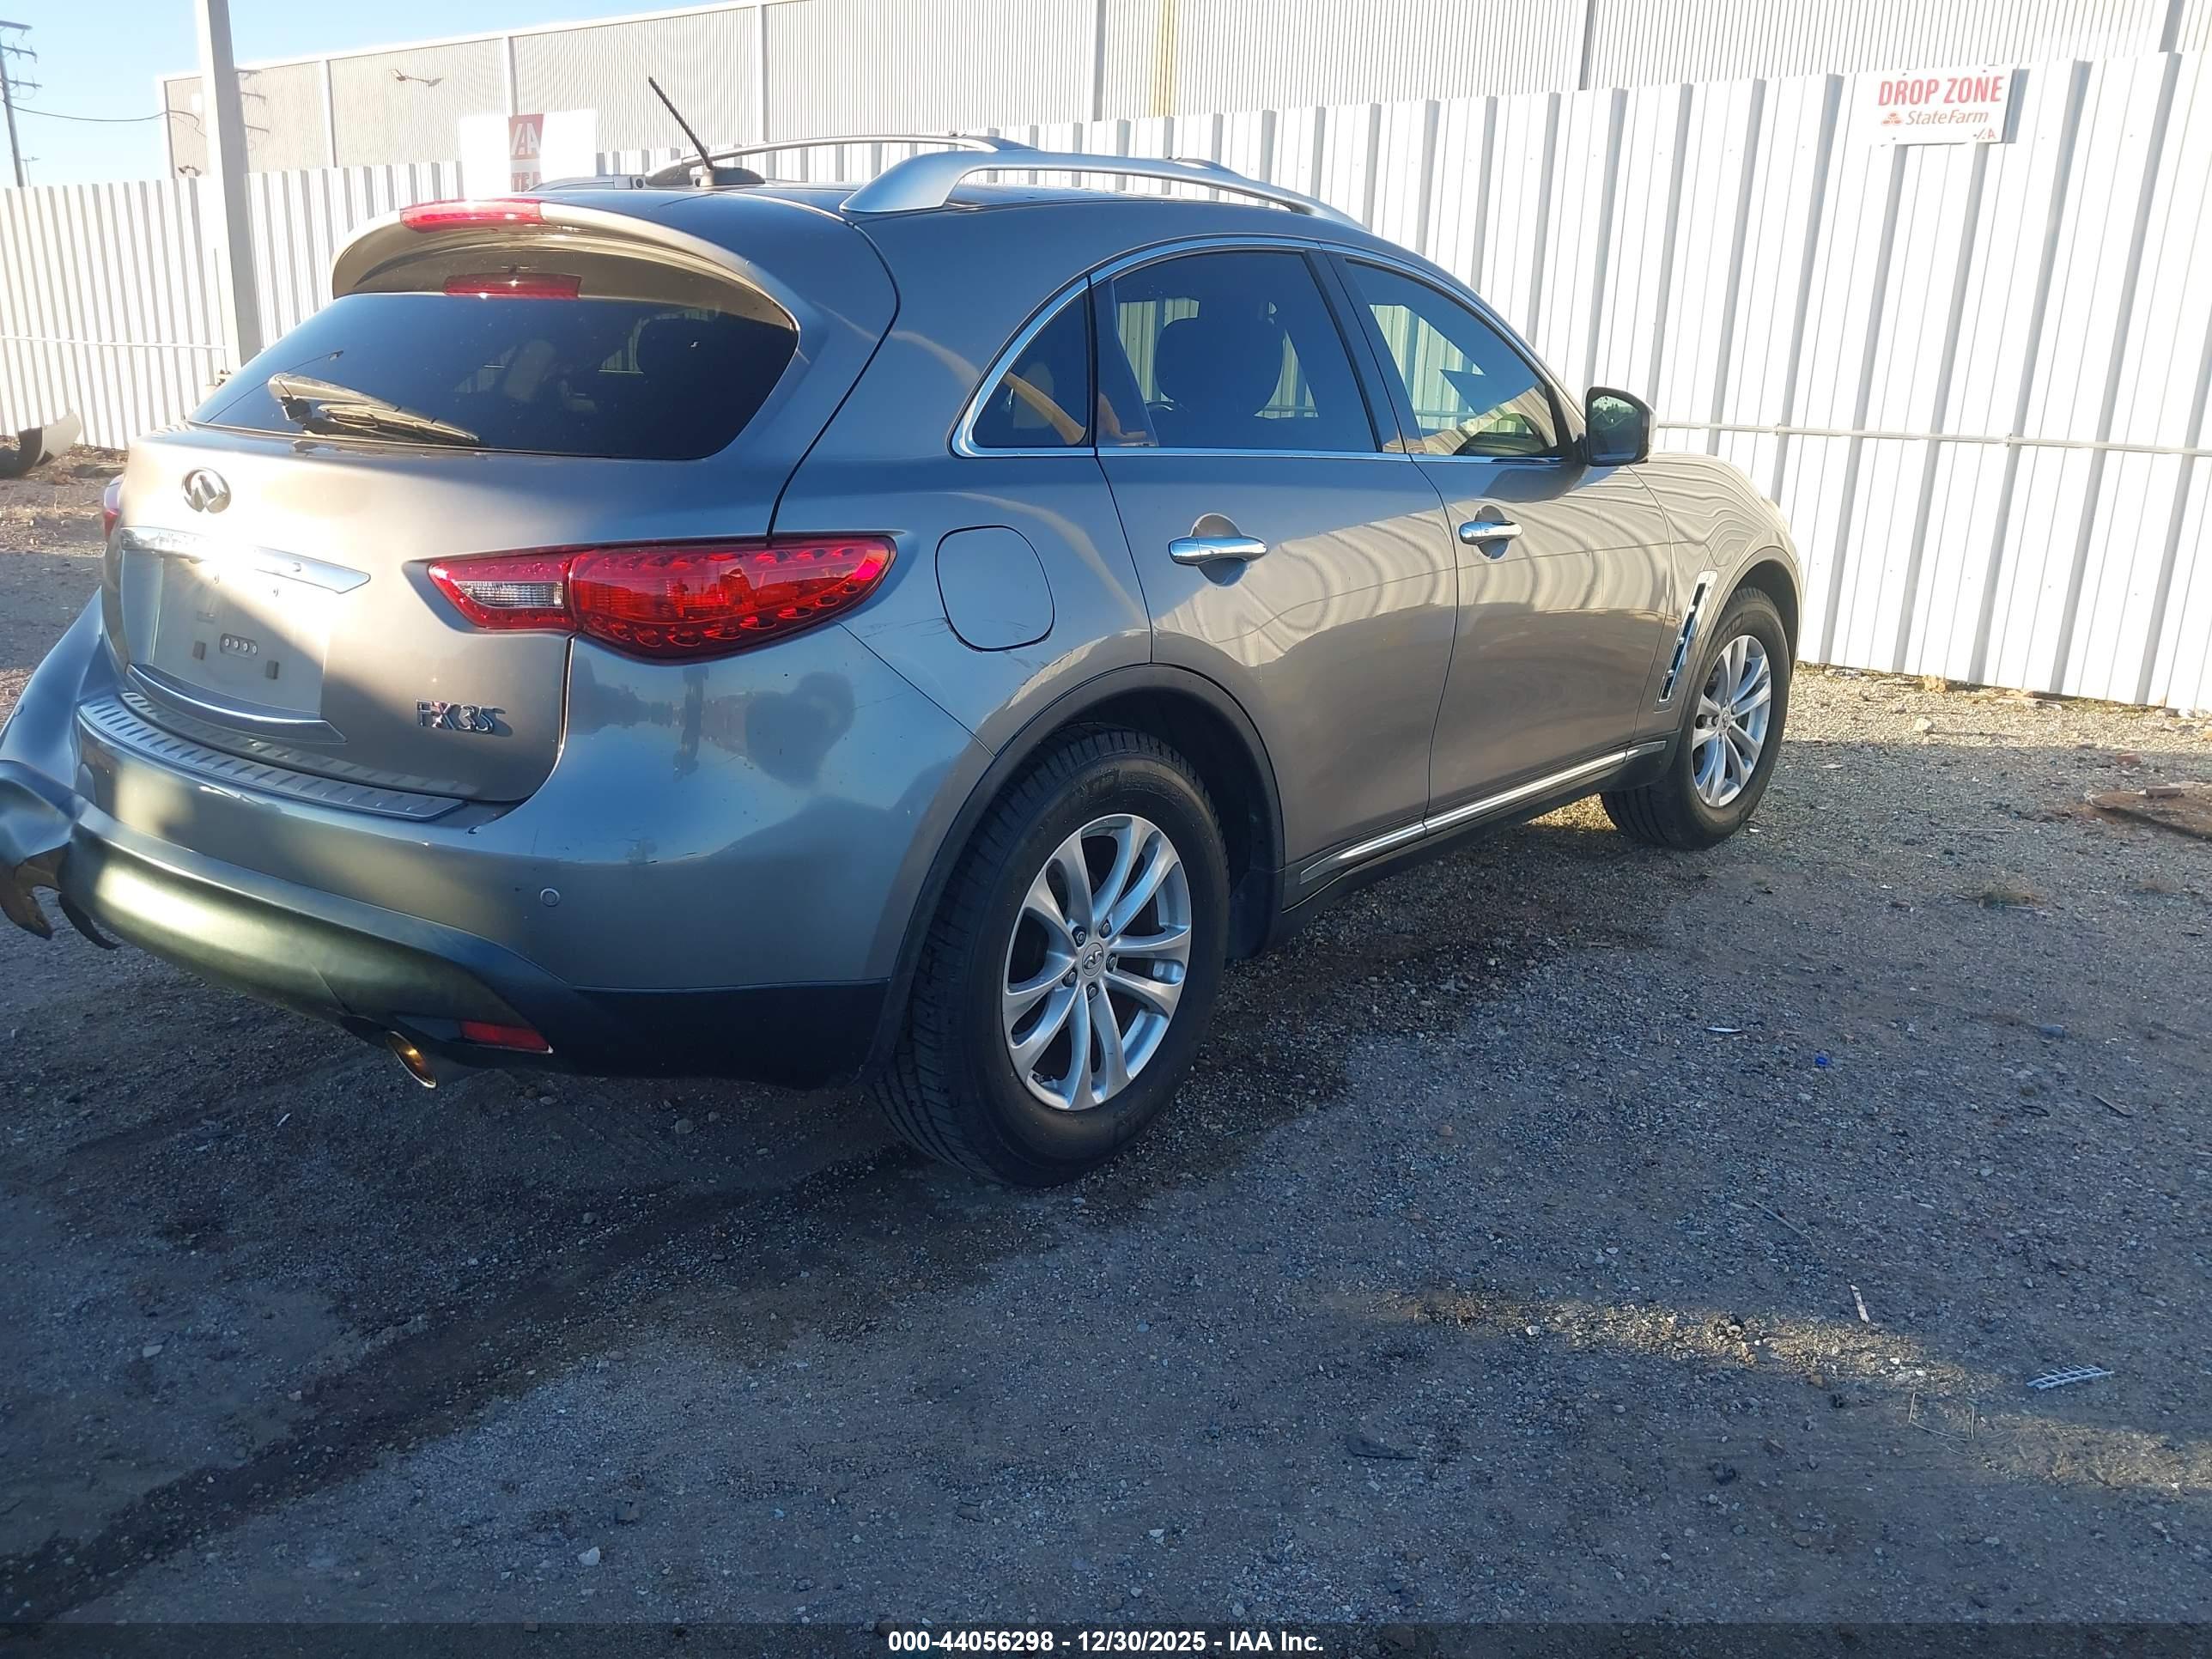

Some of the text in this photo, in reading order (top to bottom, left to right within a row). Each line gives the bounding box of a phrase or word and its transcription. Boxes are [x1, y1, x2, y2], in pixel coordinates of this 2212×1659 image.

[1878, 76, 2005, 106] DROP ZONE
[416, 699, 507, 734] FX35
